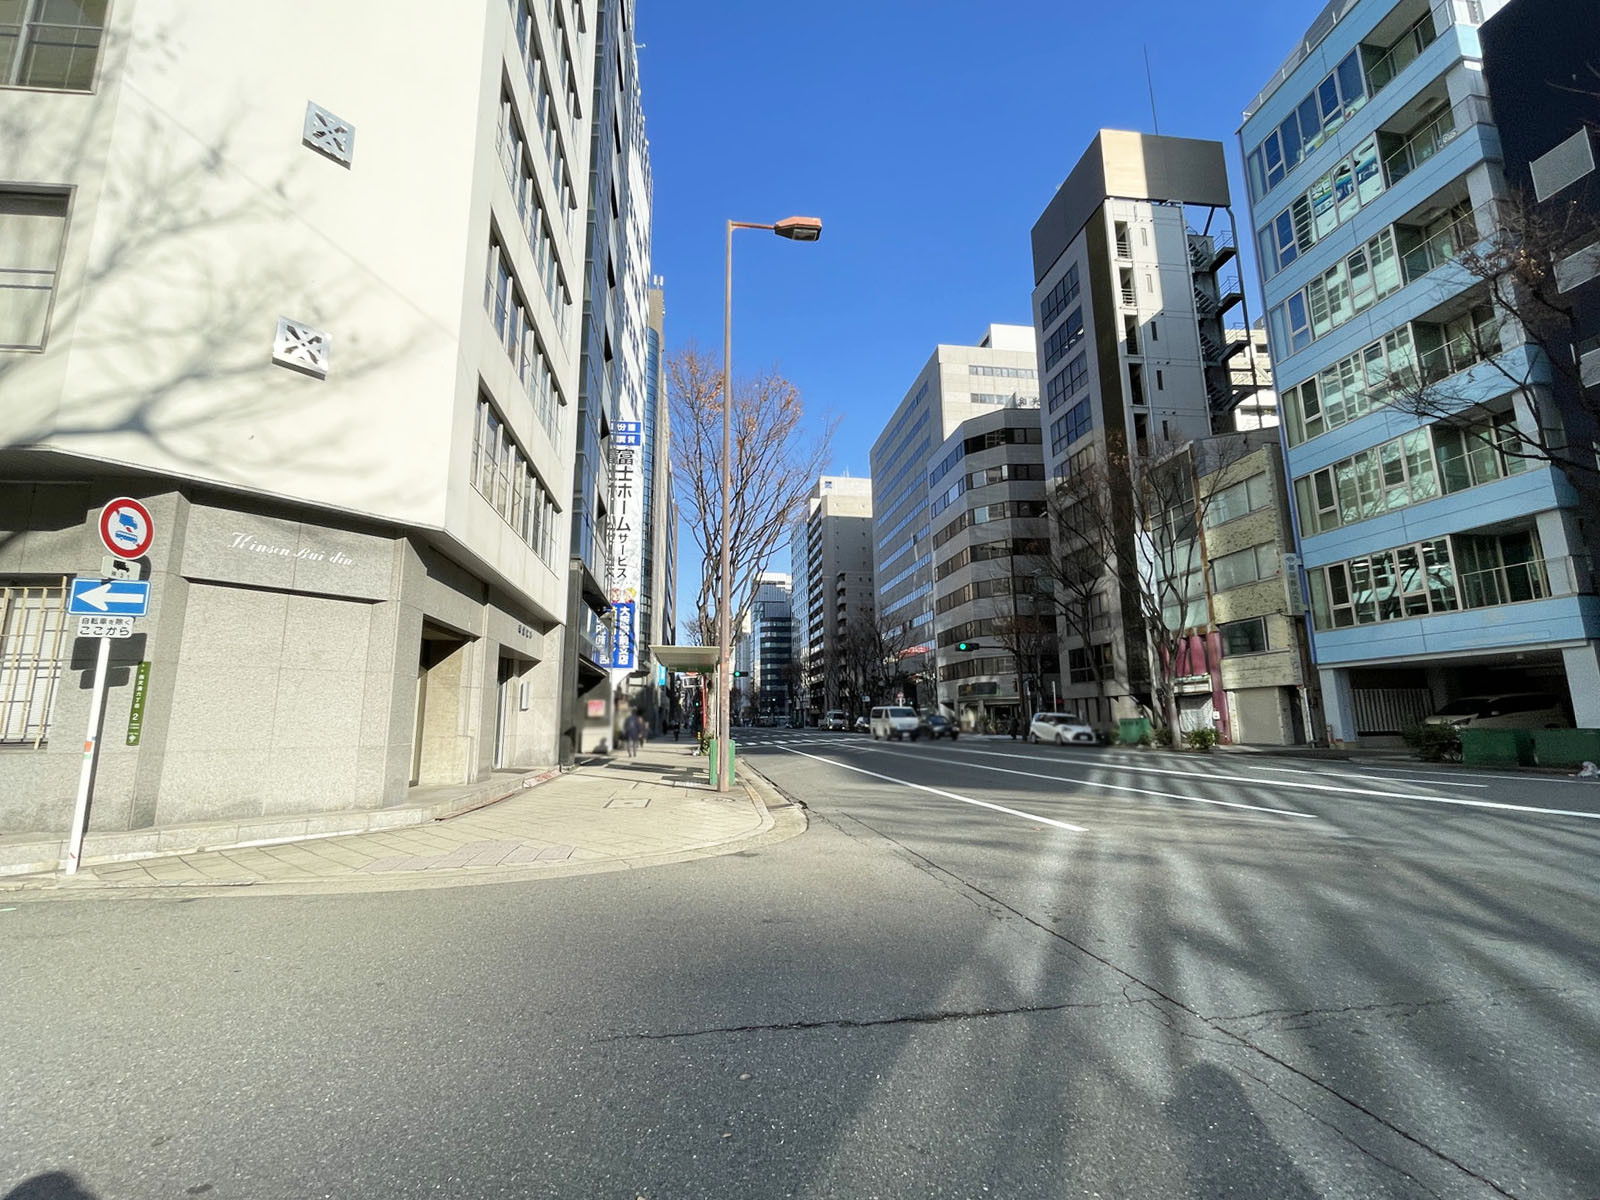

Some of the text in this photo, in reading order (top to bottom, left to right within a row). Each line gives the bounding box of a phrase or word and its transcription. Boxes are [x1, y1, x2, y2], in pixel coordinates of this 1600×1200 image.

[616, 449, 635, 578] 富士ホームサービス
[81, 617, 131, 626] 自転車を除く
[80, 626, 130, 636] ここから
[132, 712, 139, 721] 2
